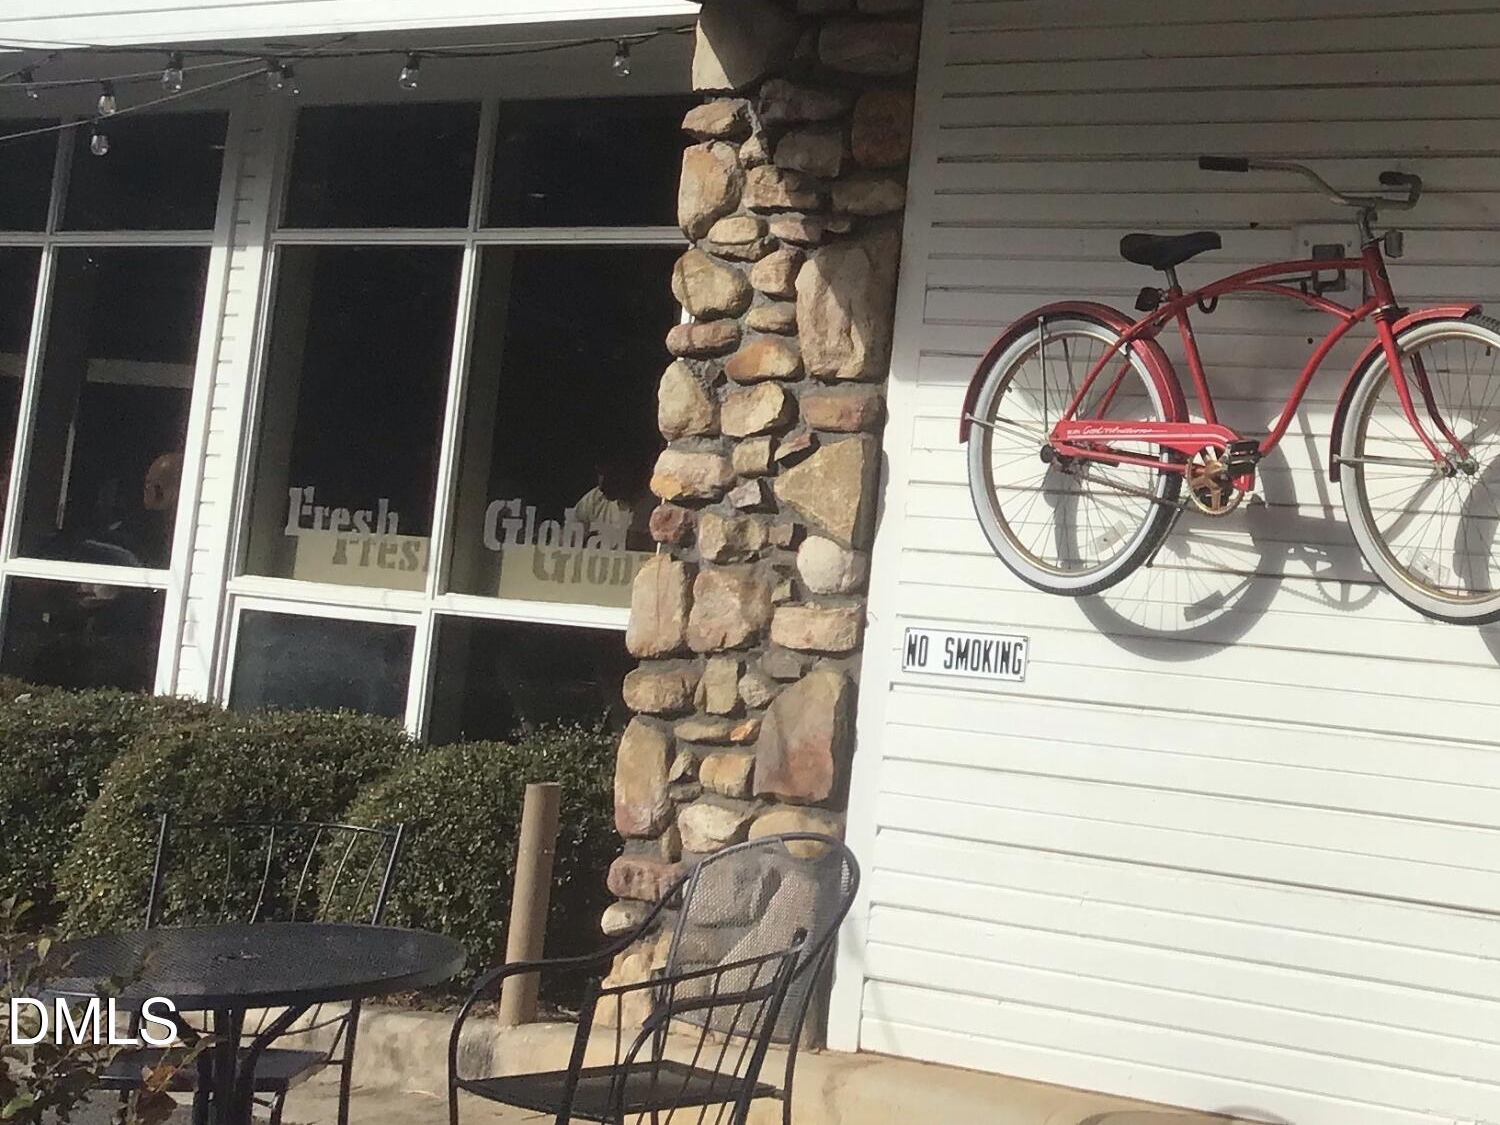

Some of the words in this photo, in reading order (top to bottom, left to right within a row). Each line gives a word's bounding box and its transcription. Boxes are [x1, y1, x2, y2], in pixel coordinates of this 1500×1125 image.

[284, 486, 399, 539] Fresh
[483, 498, 634, 557] Global
[906, 633, 929, 667] NO
[943, 636, 1023, 675] SMOKING
